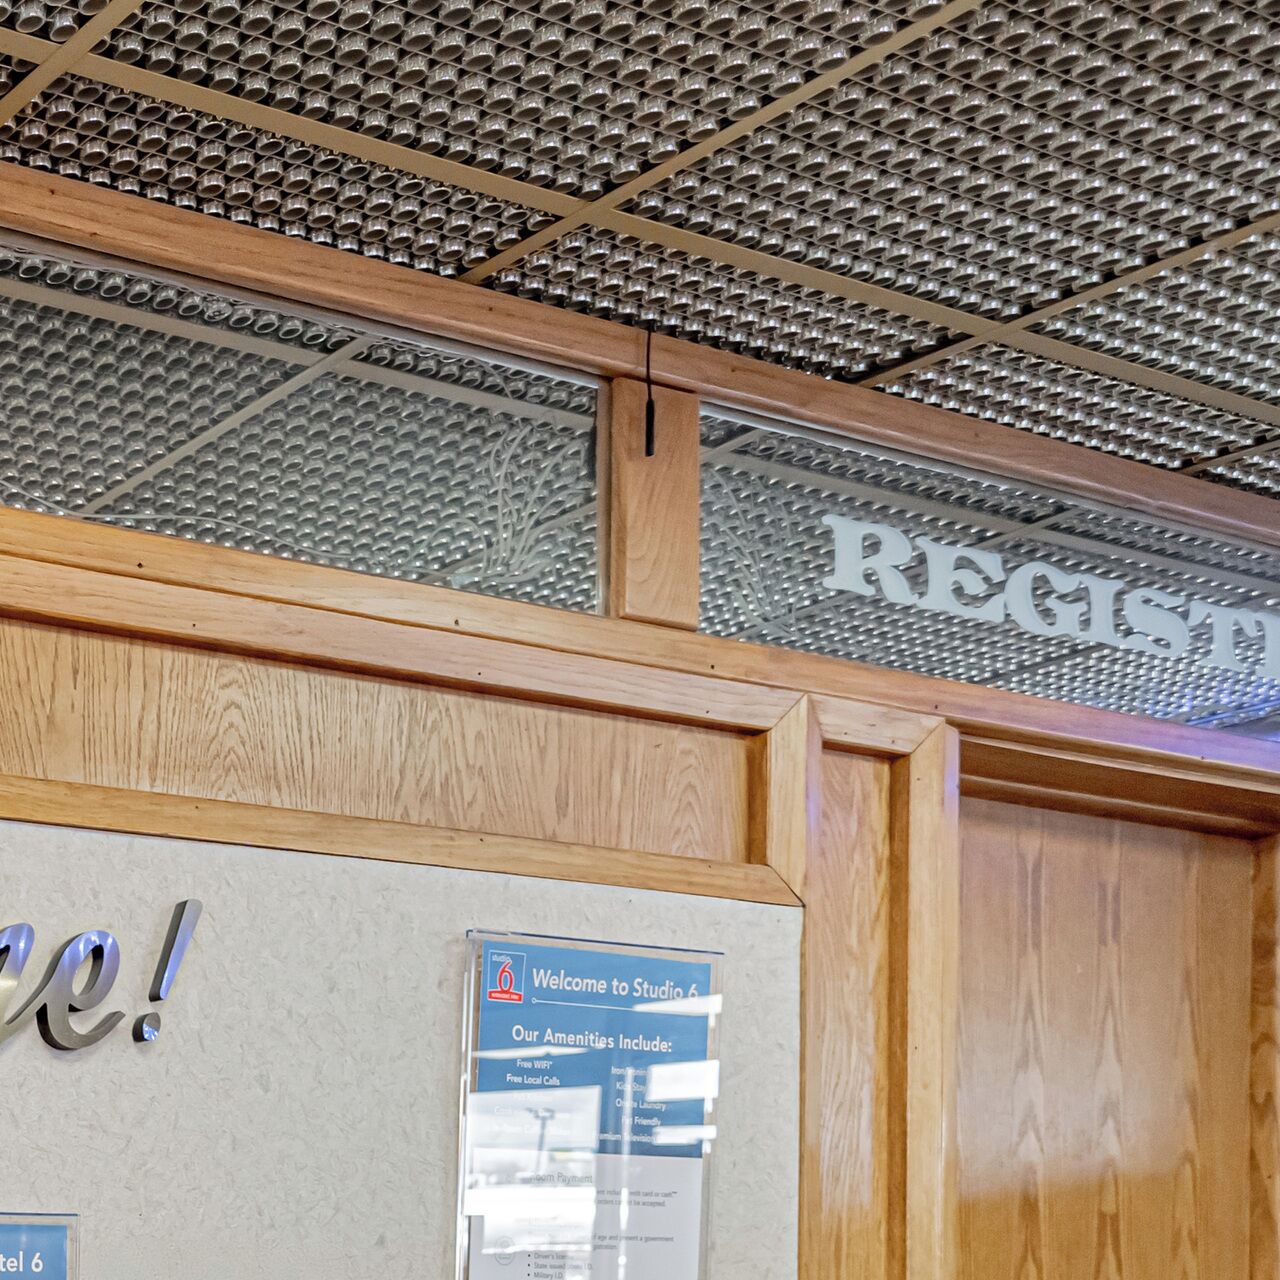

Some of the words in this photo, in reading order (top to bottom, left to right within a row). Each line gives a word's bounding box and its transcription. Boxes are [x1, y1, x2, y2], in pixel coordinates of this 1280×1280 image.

[532, 968, 607, 993] Welcome
[612, 978, 628, 996] to
[633, 978, 683, 1000] Studio
[688, 983, 699, 1000] 6
[512, 1024, 538, 1042] Our
[544, 1028, 614, 1049] Amenities
[619, 1033, 672, 1052] Include:
[516, 1059, 533, 1068] Free
[506, 1073, 522, 1083] Free
[523, 1075, 542, 1084] Local
[543, 1076, 560, 1086] Calls
[31, 1252, 43, 1272] 6
